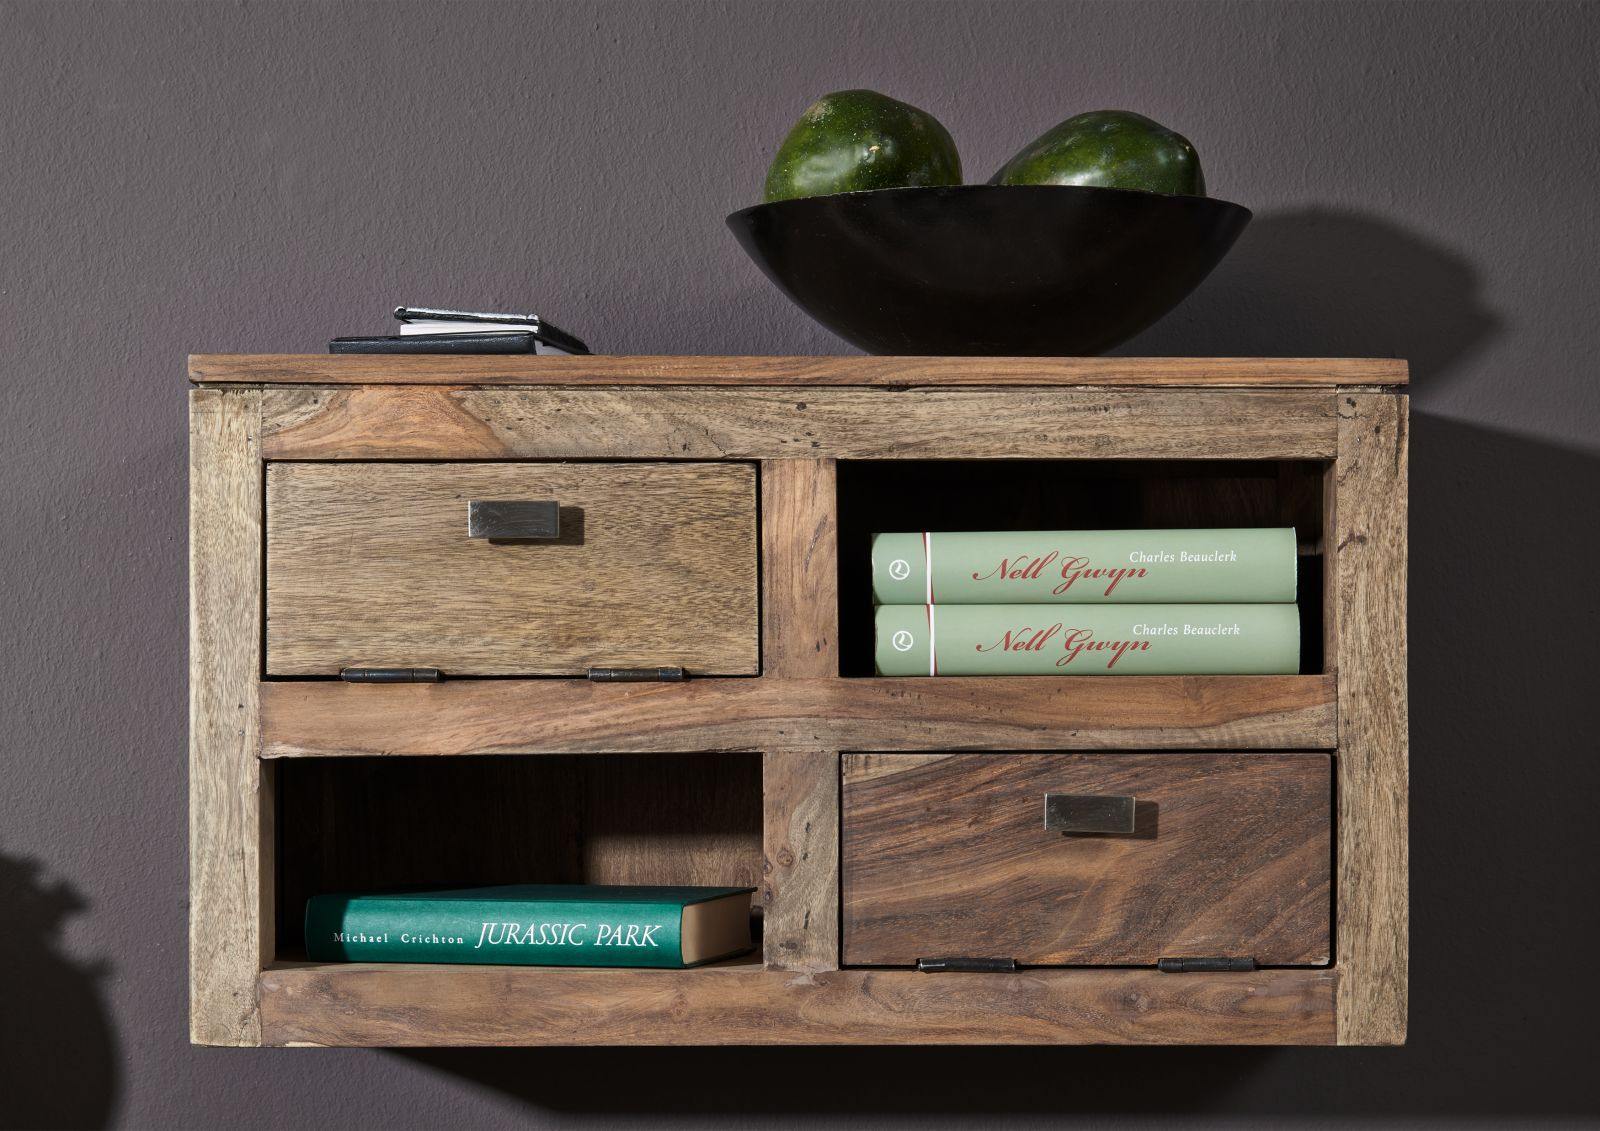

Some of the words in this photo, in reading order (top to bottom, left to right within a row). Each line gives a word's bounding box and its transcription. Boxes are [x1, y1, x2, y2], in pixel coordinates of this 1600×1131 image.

[1129, 550, 1176, 563] Charles
[1180, 550, 1237, 563] Beauclerk
[972, 550, 1059, 582] Nell
[1053, 556, 1149, 597] Gwyn
[1133, 623, 1179, 636] Charles
[1183, 623, 1240, 636] Beauclerk
[975, 622, 1064, 654] Nell
[1055, 628, 1153, 669] Gwyn
[333, 931, 389, 944] Michael
[400, 932, 464, 945] Crichton
[474, 921, 588, 950] JURASSIC
[593, 923, 663, 948] PARK
